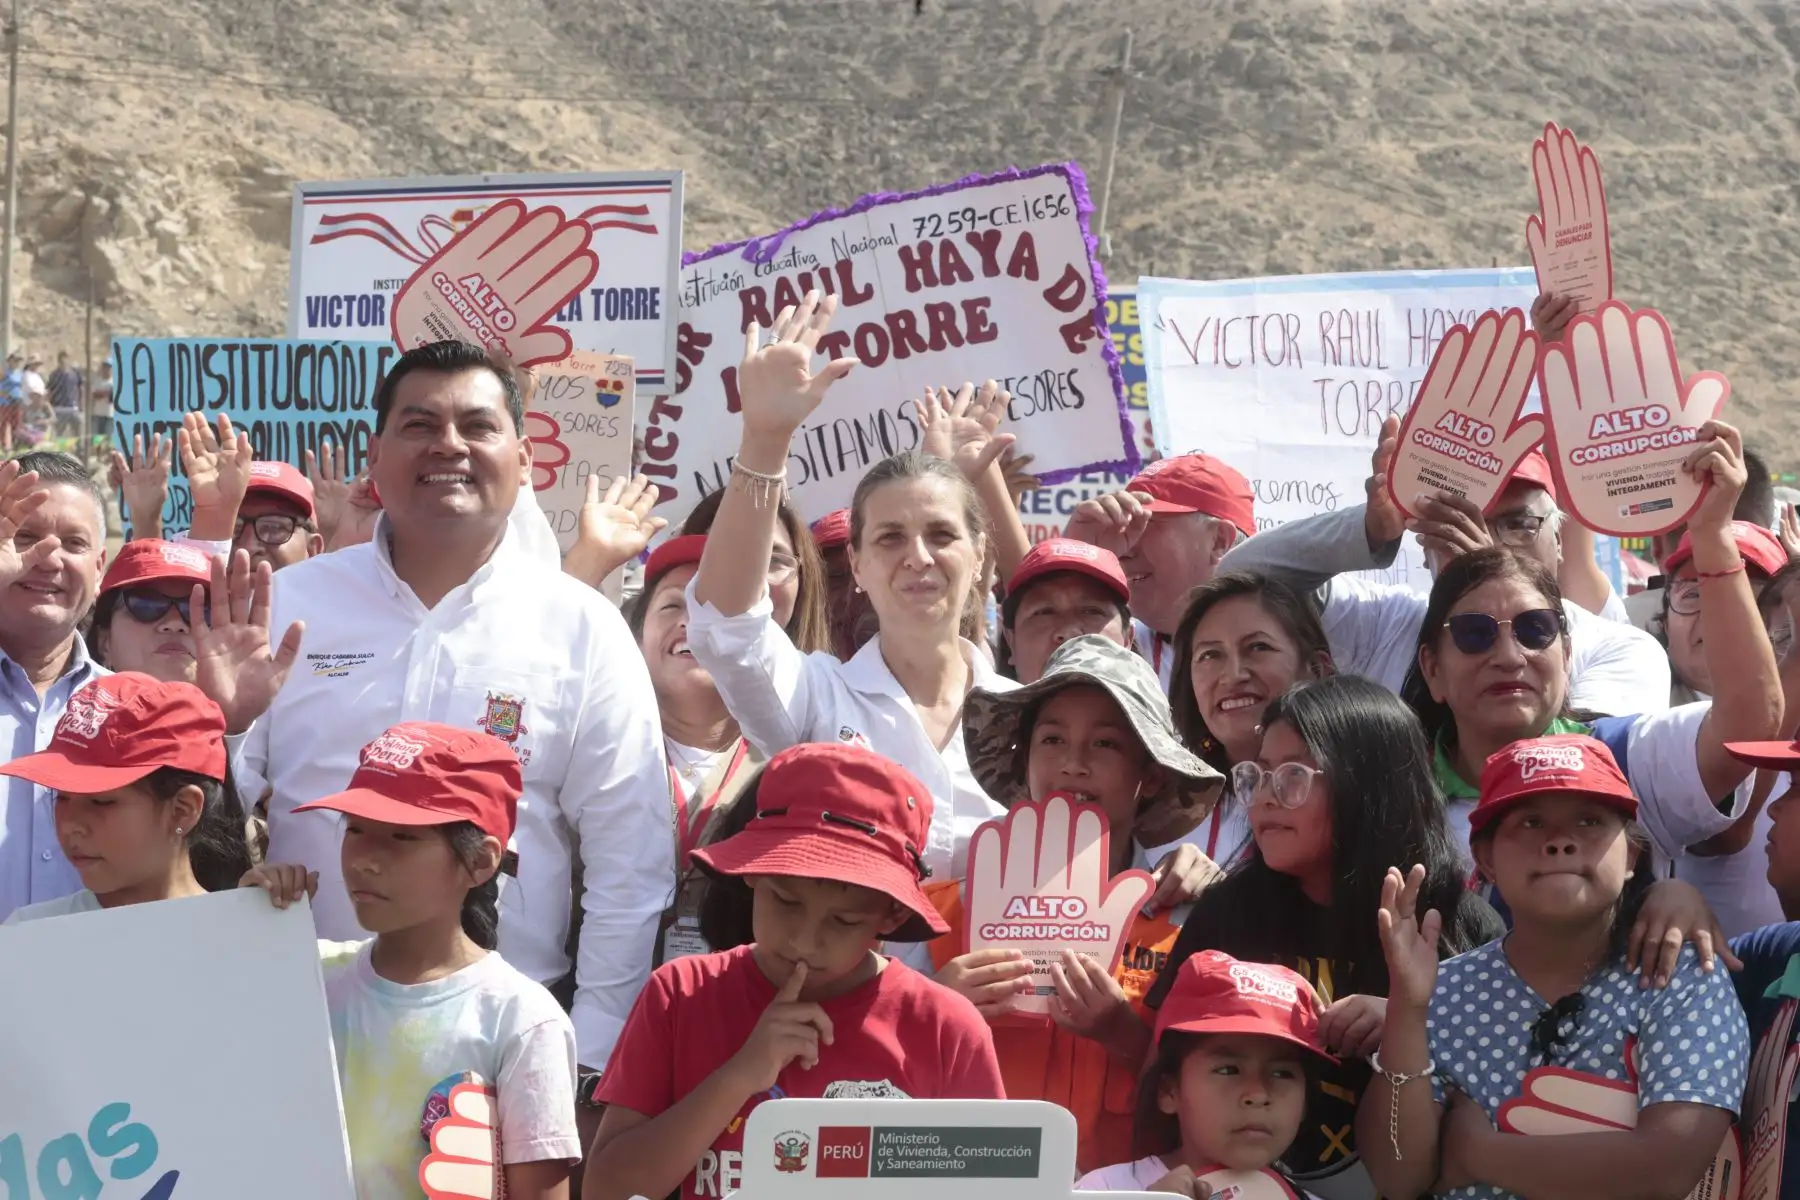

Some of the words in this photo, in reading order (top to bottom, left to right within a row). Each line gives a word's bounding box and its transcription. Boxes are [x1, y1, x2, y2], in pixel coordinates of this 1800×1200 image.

[754, 246, 818, 277] Educativa
[831, 223, 899, 263] Nacional
[898, 229, 1039, 293] HAYA
[306, 294, 385, 328] VICTOR
[591, 287, 660, 321] TORRE
[433, 273, 511, 357] CORRUPCI
[459, 274, 515, 331] ALTO
[816, 297, 998, 378] TORRE
[1319, 308, 1389, 370] RAUL
[113, 342, 156, 415] LA
[1436, 409, 1495, 447] ALTO
[1589, 403, 1670, 440] ALTO
[1413, 428, 1503, 475] CORRUPCIÓN
[1569, 425, 1698, 466] CORRUPCIÓN
[1421, 466, 1448, 481] VIVIENDA
[1606, 474, 1644, 487] VIVIENDA
[1607, 477, 1677, 497] ÍNTEGRAMENTE
[1003, 895, 1087, 919] ALTO
[979, 921, 1110, 942] CORRUPCIÓN
[823, 1142, 864, 1159] PERÚ
[878, 1145, 894, 1157] de
[897, 1145, 951, 1158] Vivienda,
[954, 1145, 1032, 1158] Construcción
[879, 1132, 940, 1144] Ministerio
[877, 1160, 884, 1171] y
[887, 1157, 966, 1170] Saneamiento
